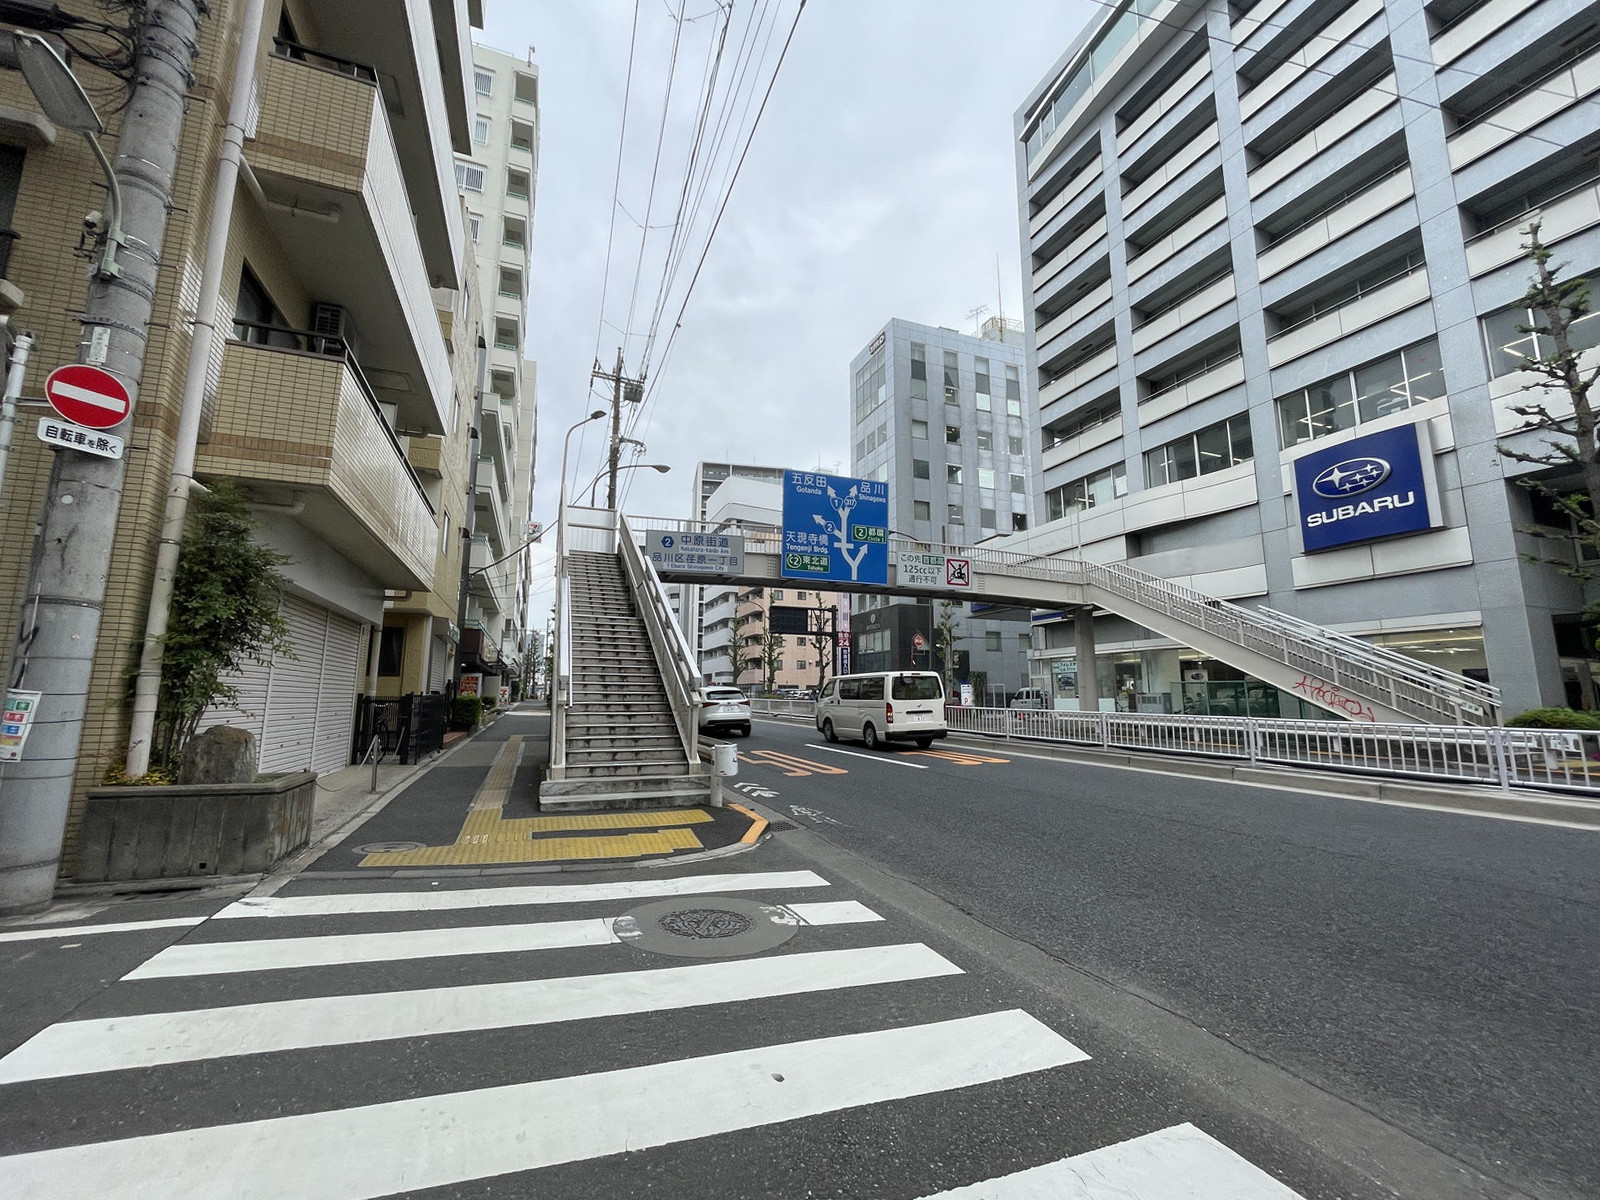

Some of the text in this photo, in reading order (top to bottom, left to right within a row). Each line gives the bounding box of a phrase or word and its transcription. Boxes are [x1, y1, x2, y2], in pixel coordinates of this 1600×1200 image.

[45, 425, 117, 454] 自転車を除く
[792, 472, 827, 488] 五反田
[796, 486, 822, 495] Gotanda
[860, 482, 885, 495] 品川
[858, 493, 886, 503] Shinagawa
[1306, 491, 1415, 528] SUBARU
[827, 523, 833, 532] 2
[858, 528, 864, 537] 2
[664, 537, 671, 547] 2
[681, 534, 729, 548] 中原街道
[786, 530, 829, 546] 天現寺橋
[786, 543, 813, 553] Tengenji
[652, 552, 738, 566] 品川区荏原一丁目
[802, 555, 828, 566] 東北道
[903, 564, 942, 575] 125cc以下
[908, 574, 937, 585] 通行不可
